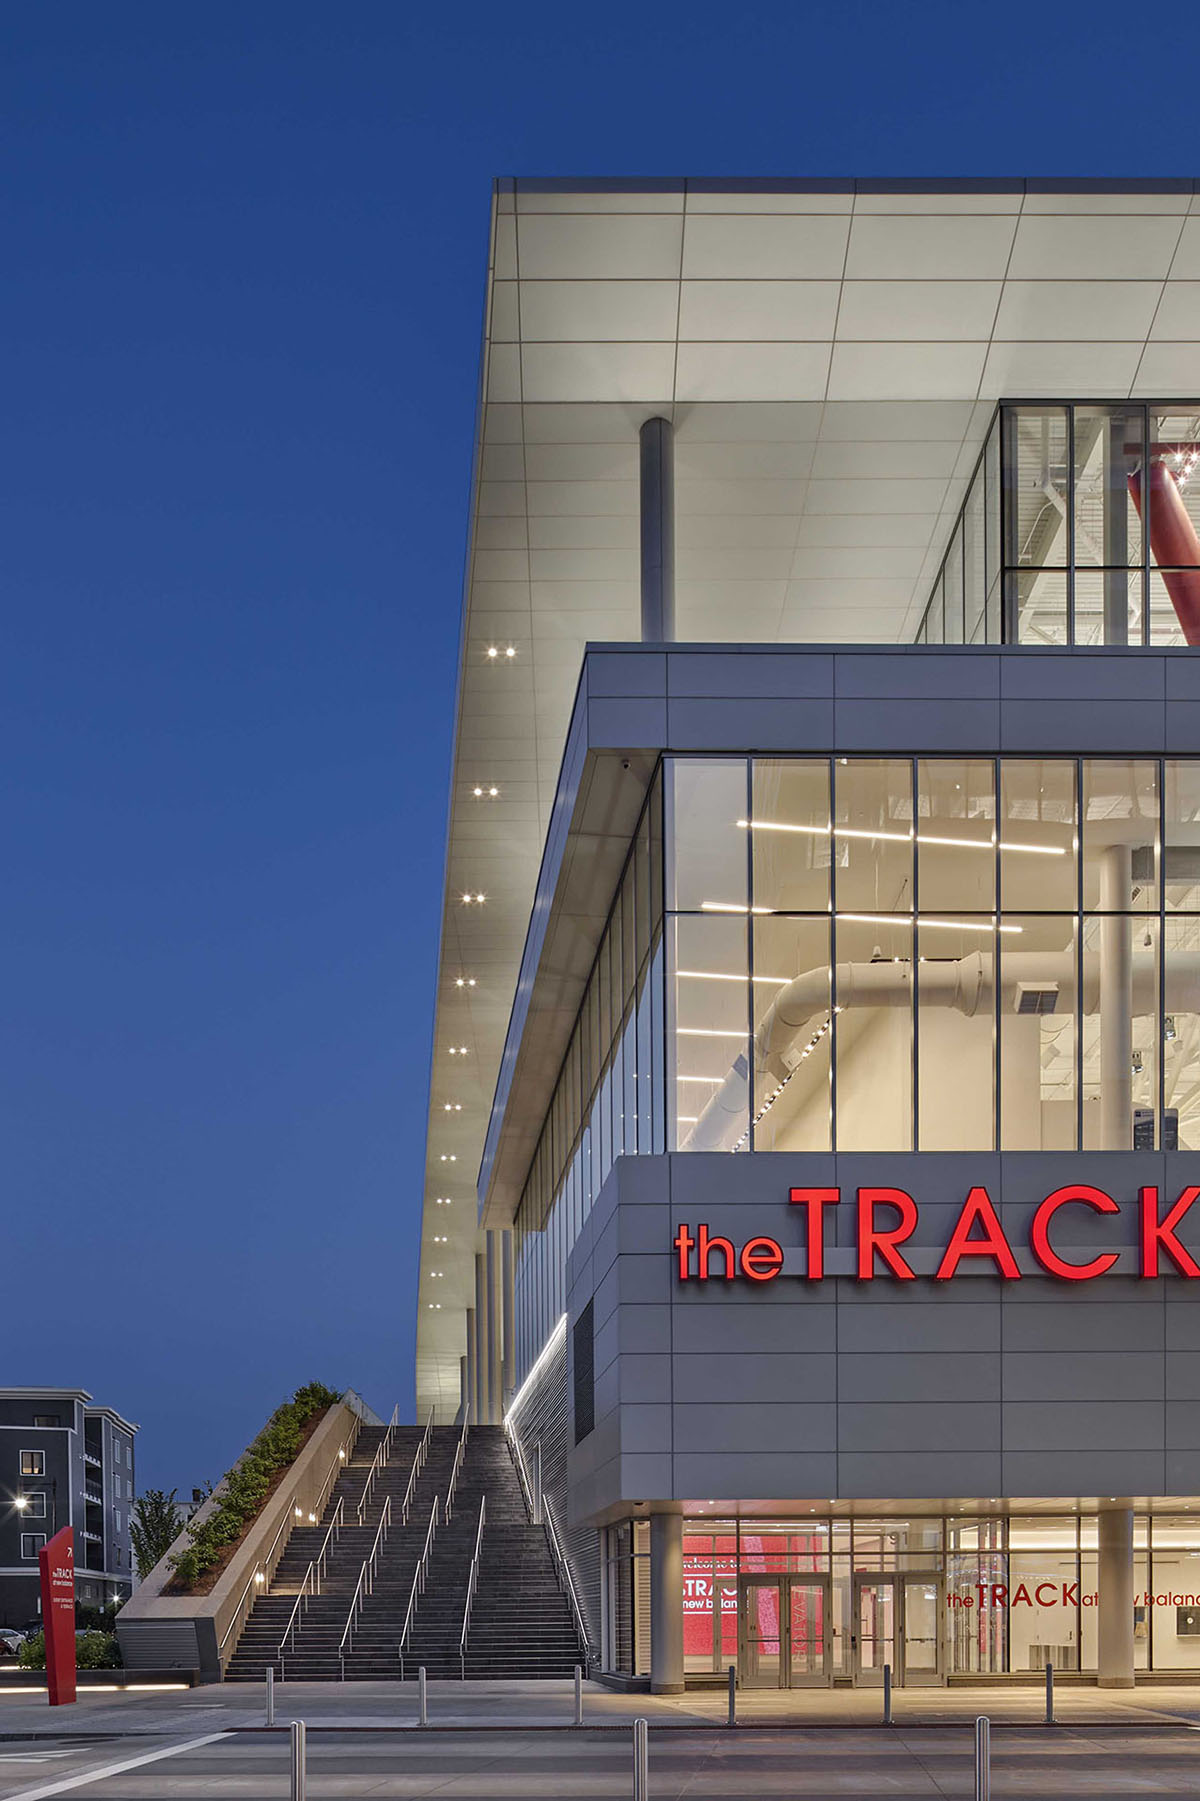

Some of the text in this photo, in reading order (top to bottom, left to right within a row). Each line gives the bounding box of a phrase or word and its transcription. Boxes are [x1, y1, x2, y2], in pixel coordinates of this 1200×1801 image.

[673, 1223, 784, 1282] the
[683, 1601, 704, 1609] new
[946, 1593, 974, 1608] the
[975, 1583, 1079, 1608] TRACK
[1082, 1593, 1099, 1607] at
